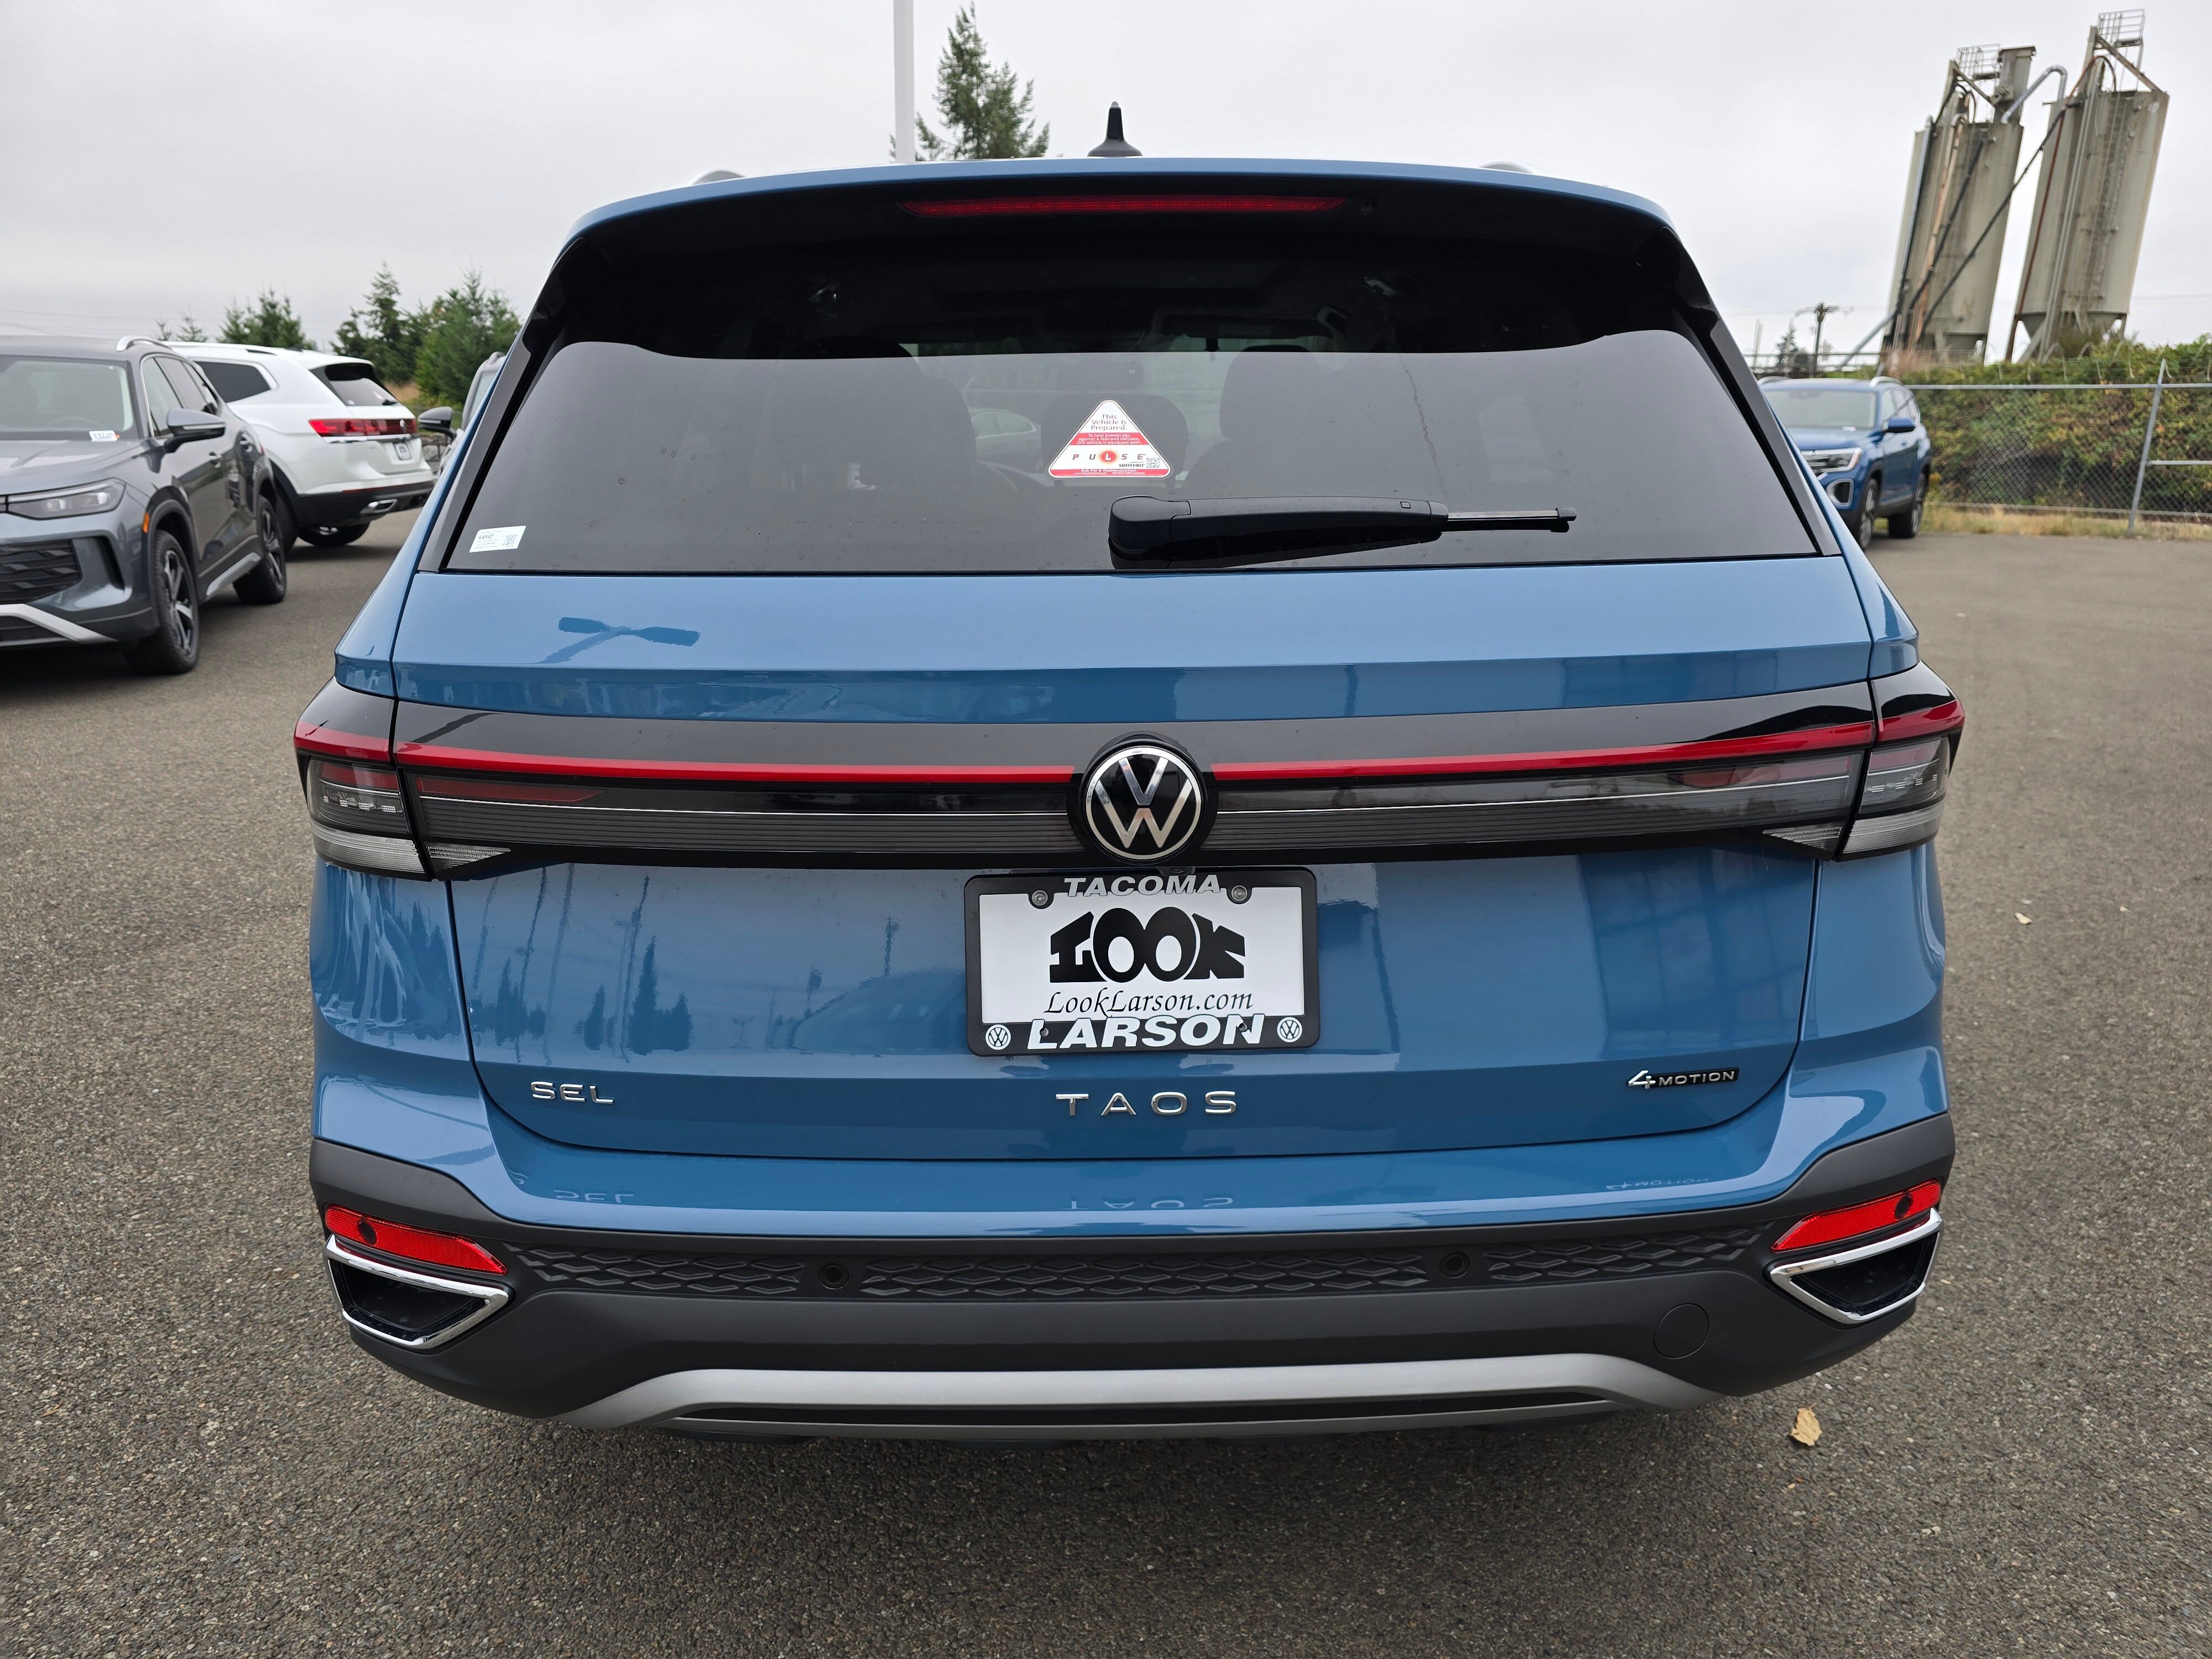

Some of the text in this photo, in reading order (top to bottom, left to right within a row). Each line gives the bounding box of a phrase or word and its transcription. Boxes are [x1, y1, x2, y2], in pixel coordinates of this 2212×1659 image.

[1063, 874, 1221, 897] TACOMA
[1050, 906, 1245, 983] LOOK
[1044, 987, 1254, 1017] LookLarson.com
[1027, 1014, 1265, 1050] LARSON
[1627, 1070, 1735, 1089] 4MOTION
[531, 1081, 615, 1104] SEL
[1056, 1091, 1237, 1116] TAOS
